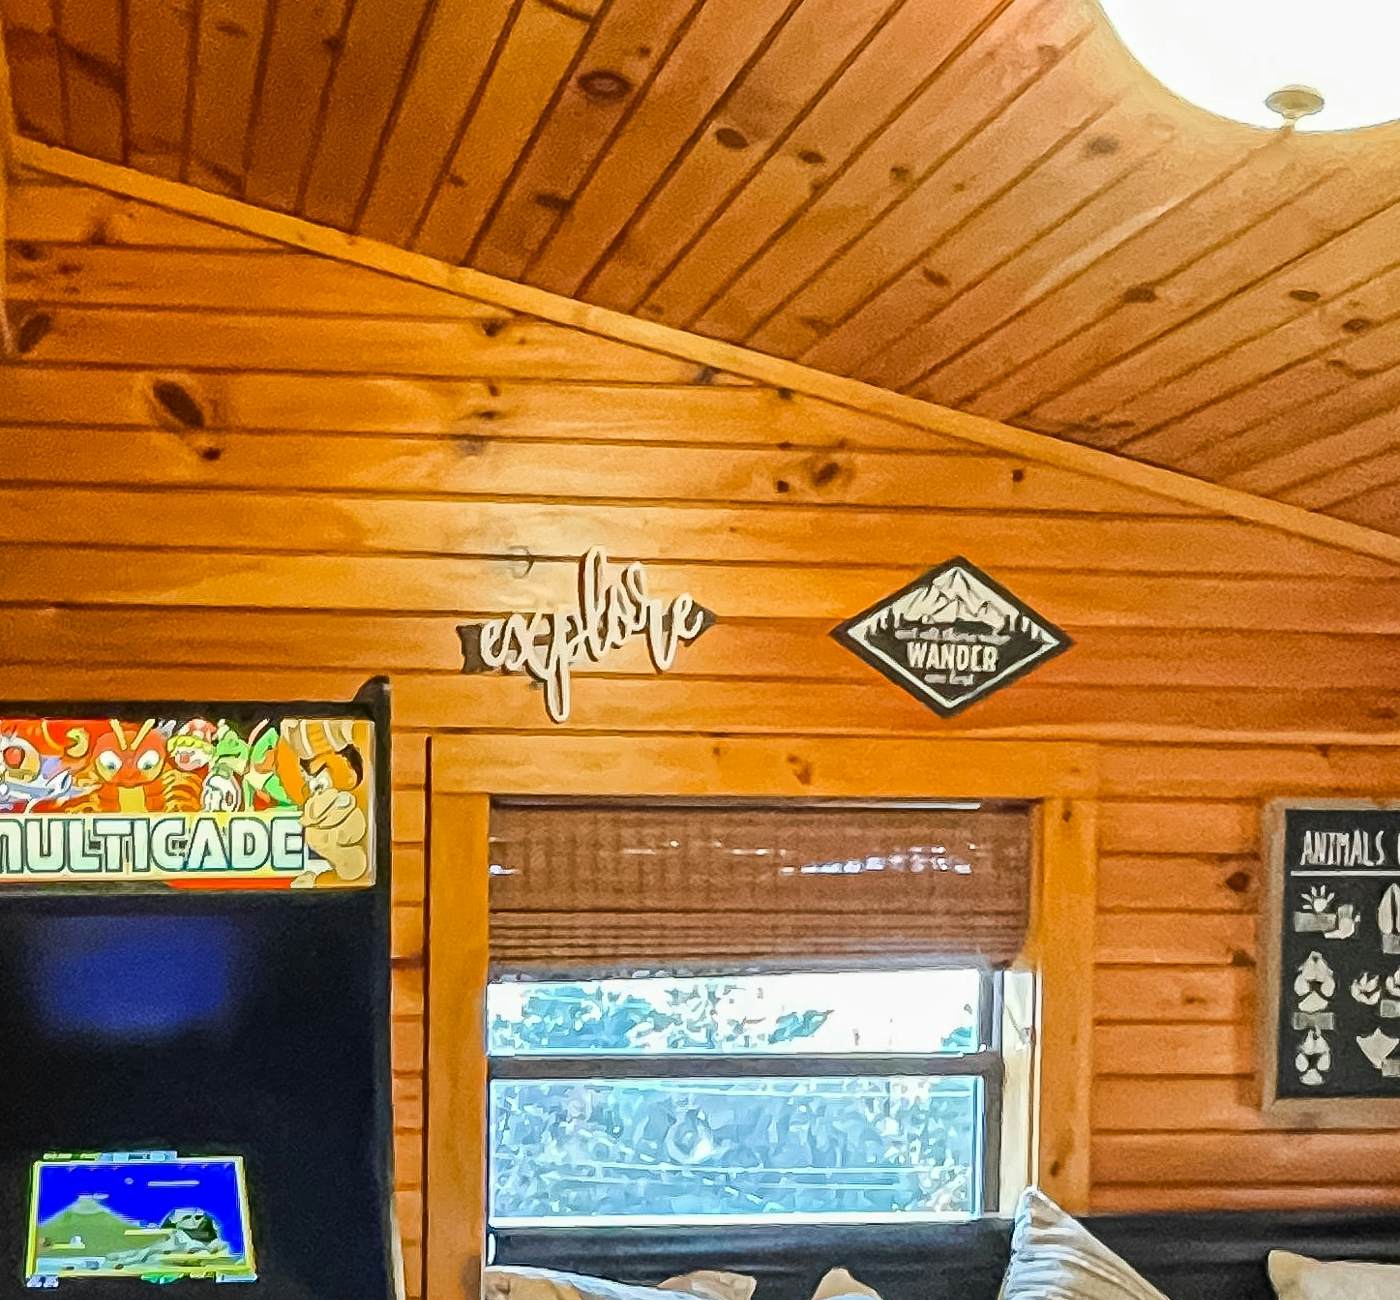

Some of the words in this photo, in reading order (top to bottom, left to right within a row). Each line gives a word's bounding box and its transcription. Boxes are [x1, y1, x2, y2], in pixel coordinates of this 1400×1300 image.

[480, 544, 704, 723] explore
[906, 641, 998, 672] WANDER
[1300, 829, 1385, 866] ANIMALS
